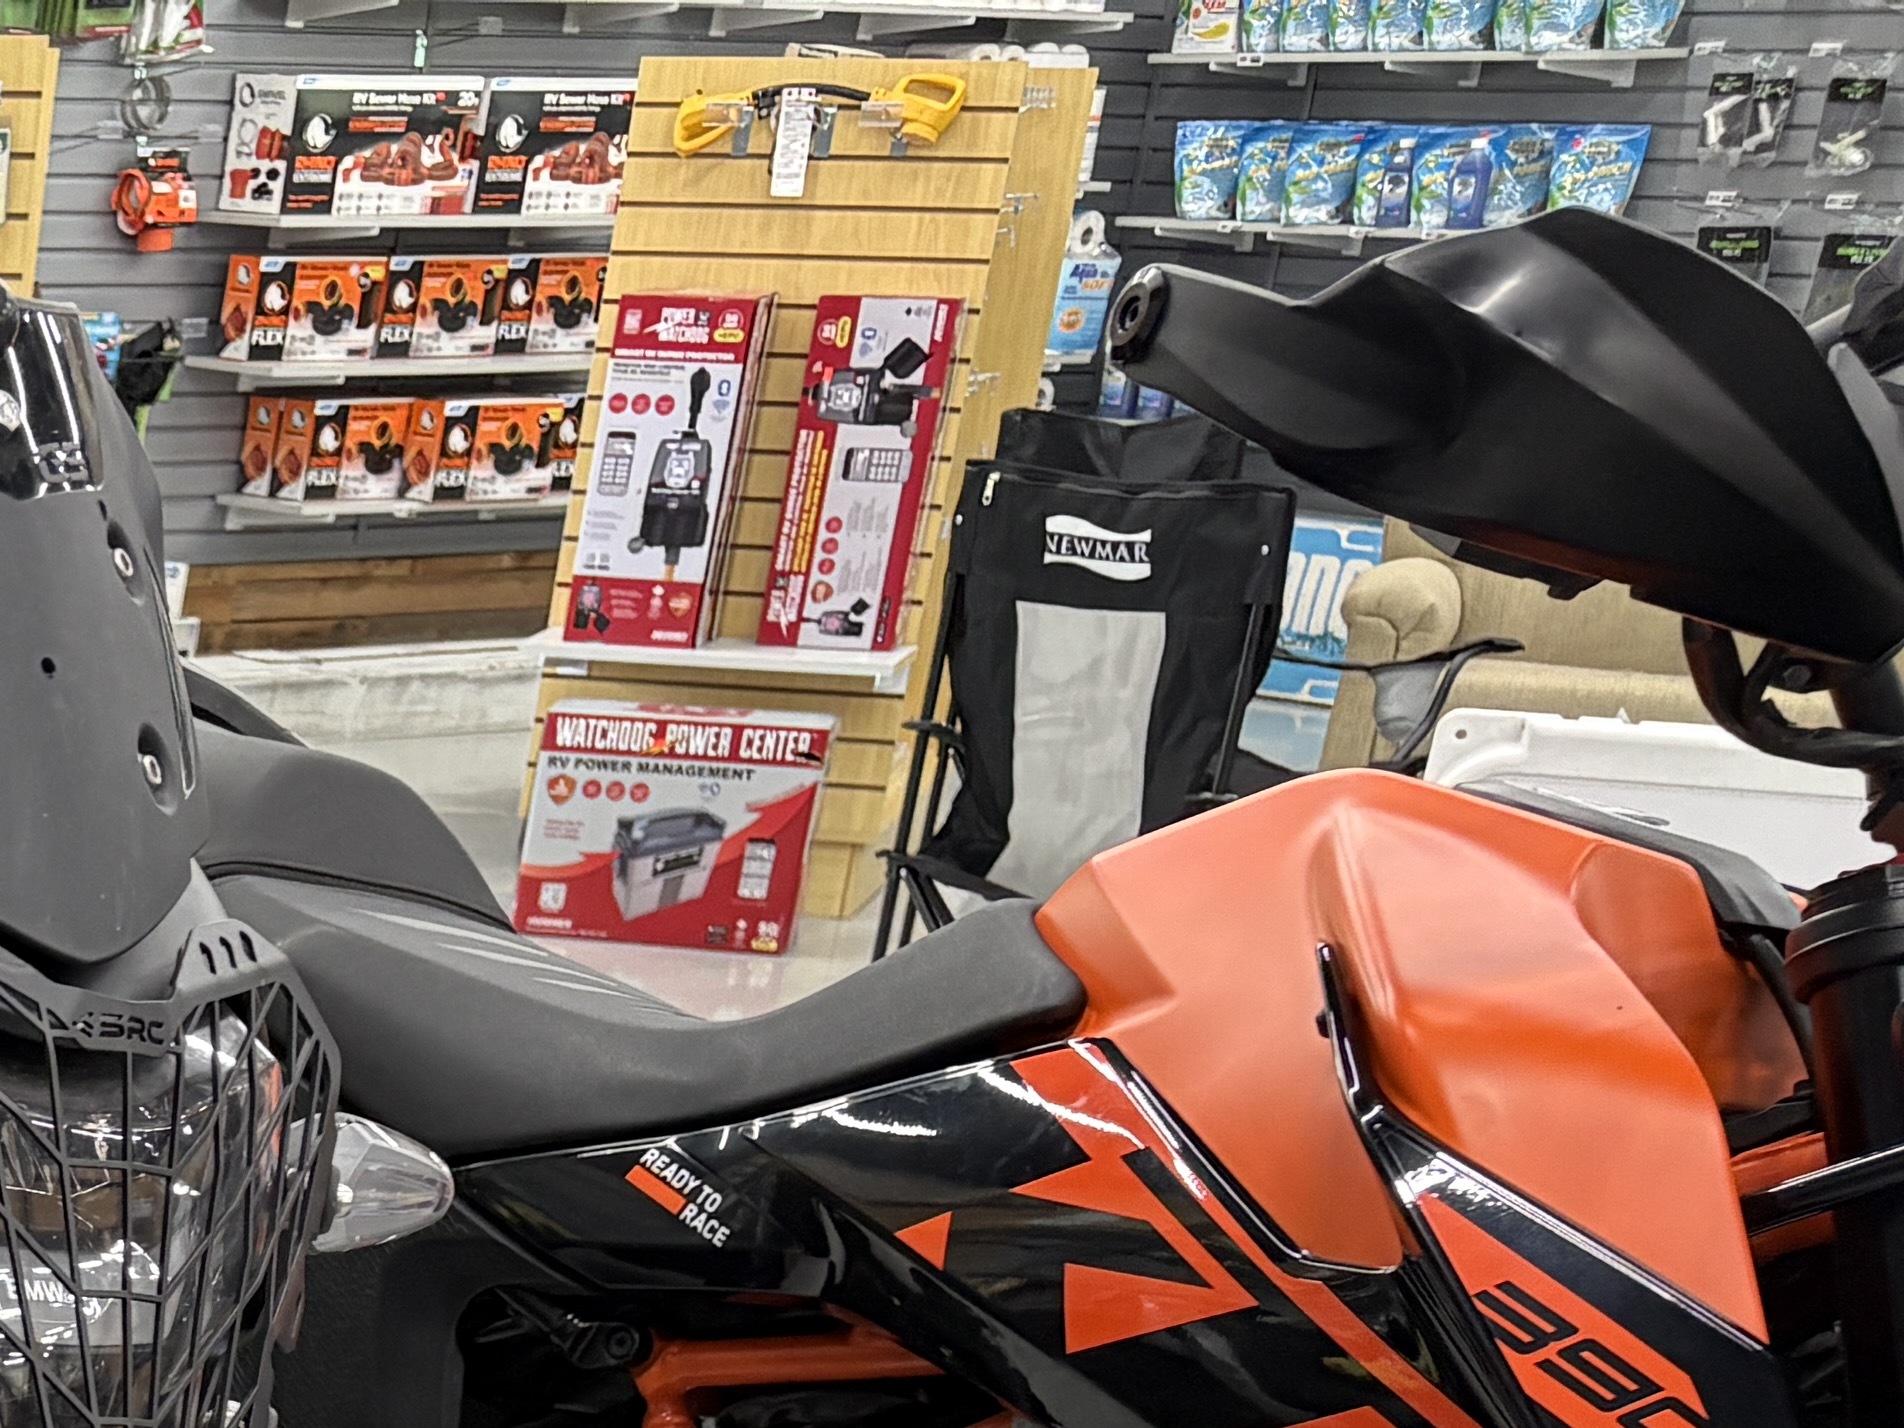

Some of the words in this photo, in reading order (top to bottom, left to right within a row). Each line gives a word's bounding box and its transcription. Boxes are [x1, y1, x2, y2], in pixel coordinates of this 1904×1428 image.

[251, 329, 284, 346] FLEX
[380, 326, 411, 343] FLEX
[498, 324, 529, 341] FLEX
[1045, 534, 1150, 563] NEWMAR
[556, 716, 657, 753] WATCHDOG
[665, 722, 733, 758] POWER
[739, 728, 812, 763] CENTER
[547, 755, 570, 770] RV
[574, 757, 632, 774] POWER
[636, 761, 757, 781] MANAGEMENT
[99, 1012, 164, 1046] SRC
[639, 1148, 703, 1195] READY
[696, 1184, 723, 1213] TO
[678, 1202, 732, 1248] RACE
